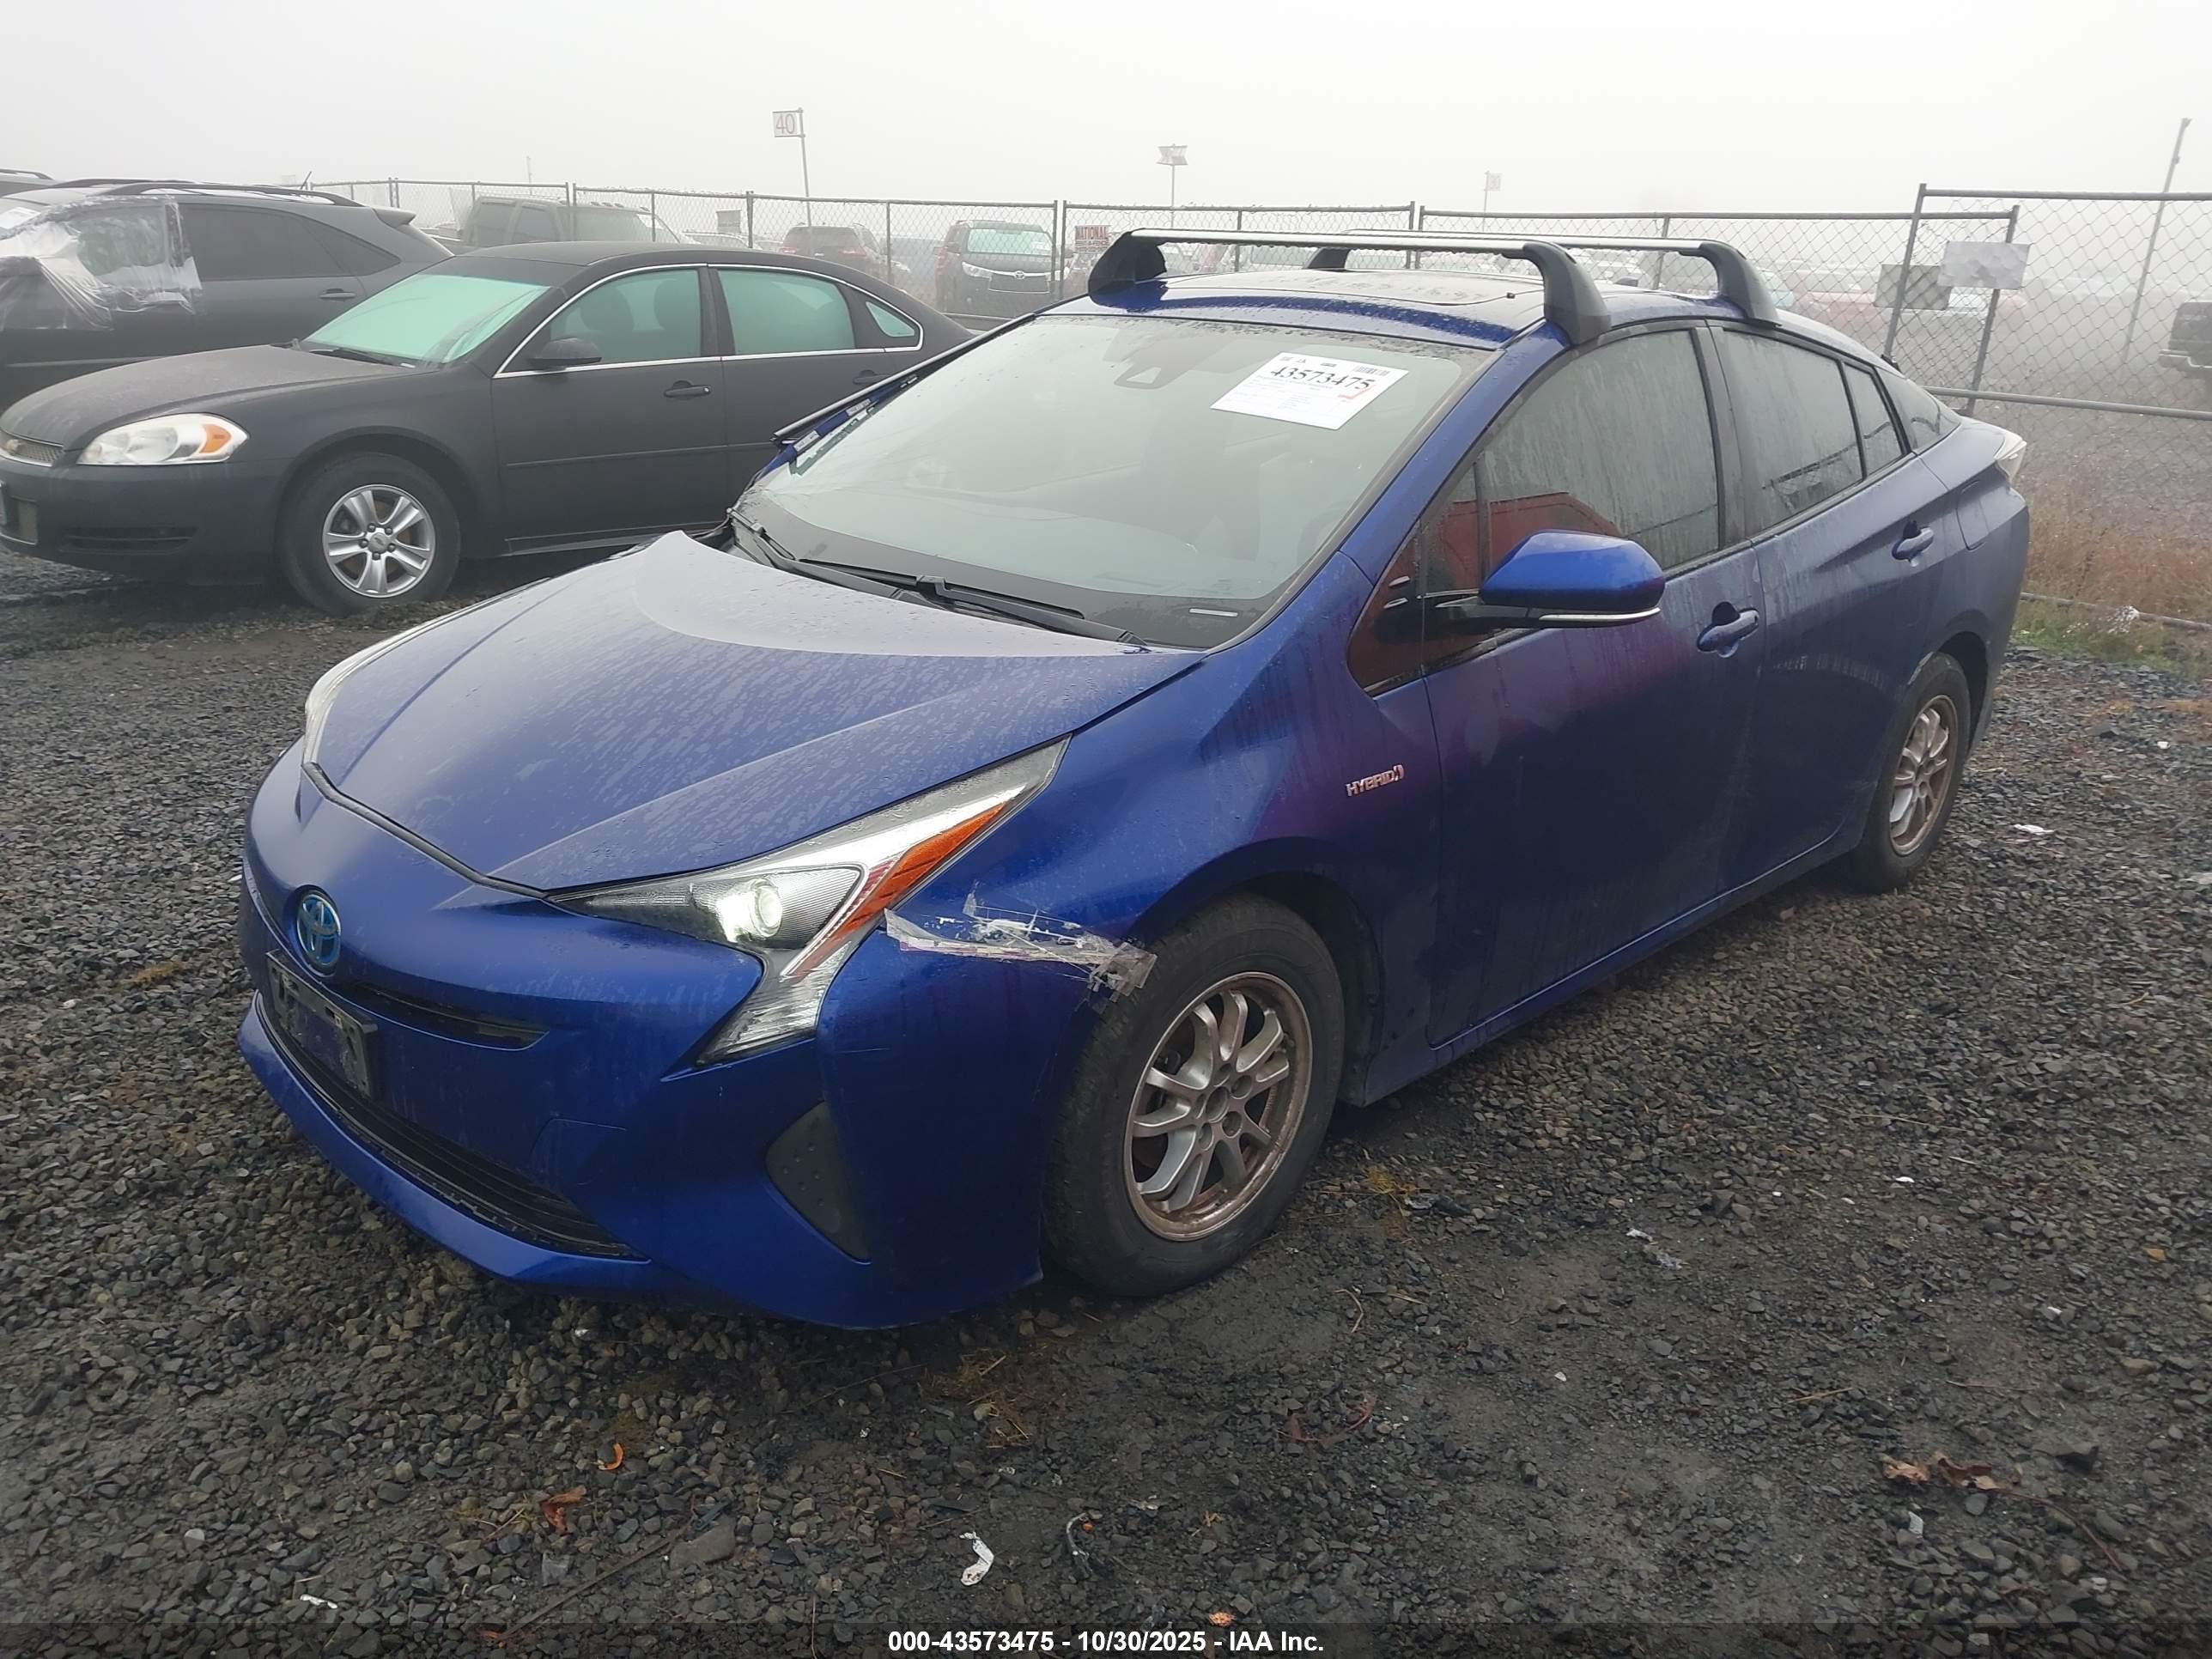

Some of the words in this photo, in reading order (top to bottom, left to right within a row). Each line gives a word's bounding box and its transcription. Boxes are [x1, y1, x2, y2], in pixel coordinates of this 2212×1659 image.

[775, 113, 795, 134] 40
[1271, 366, 1376, 389] 43573475
[1346, 769, 1395, 796] HYBRID
